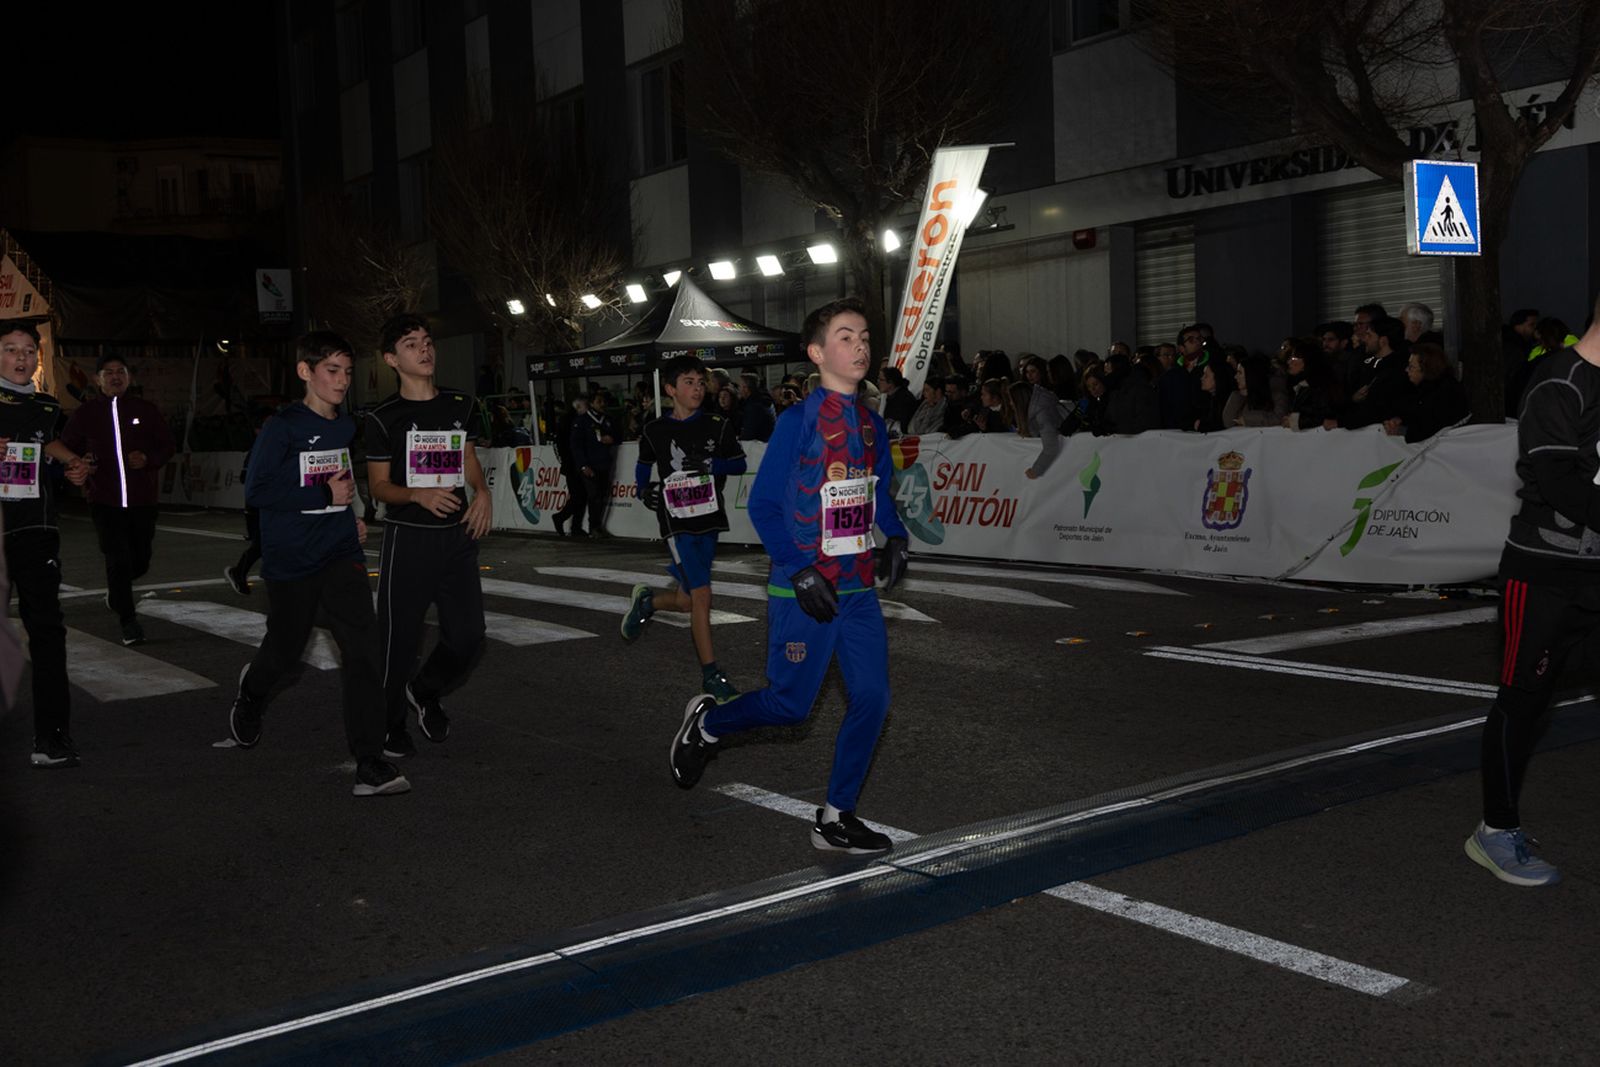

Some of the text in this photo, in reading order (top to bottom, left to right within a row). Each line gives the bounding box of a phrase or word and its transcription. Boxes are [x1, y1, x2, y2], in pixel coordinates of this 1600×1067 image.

[1165, 145, 1361, 199] UNIVERSID
[915, 320, 935, 370] obras
[535, 466, 561, 488] SAN
[933, 462, 987, 492] SAN
[533, 485, 571, 511] ANTÓ
[839, 487, 859, 497] NOCHE
[895, 474, 928, 519] 43
[831, 498, 846, 507] SAN
[927, 488, 1018, 528] ANTÓN
[1373, 509, 1450, 523] DIPUTACIÓN
[1059, 532, 1082, 541] Deportes
[1079, 525, 1105, 534] Municipal
[1367, 525, 1419, 538] DE JAÉN
[1210, 534, 1251, 543] Ayuntamiento
[1203, 543, 1212, 552] de
